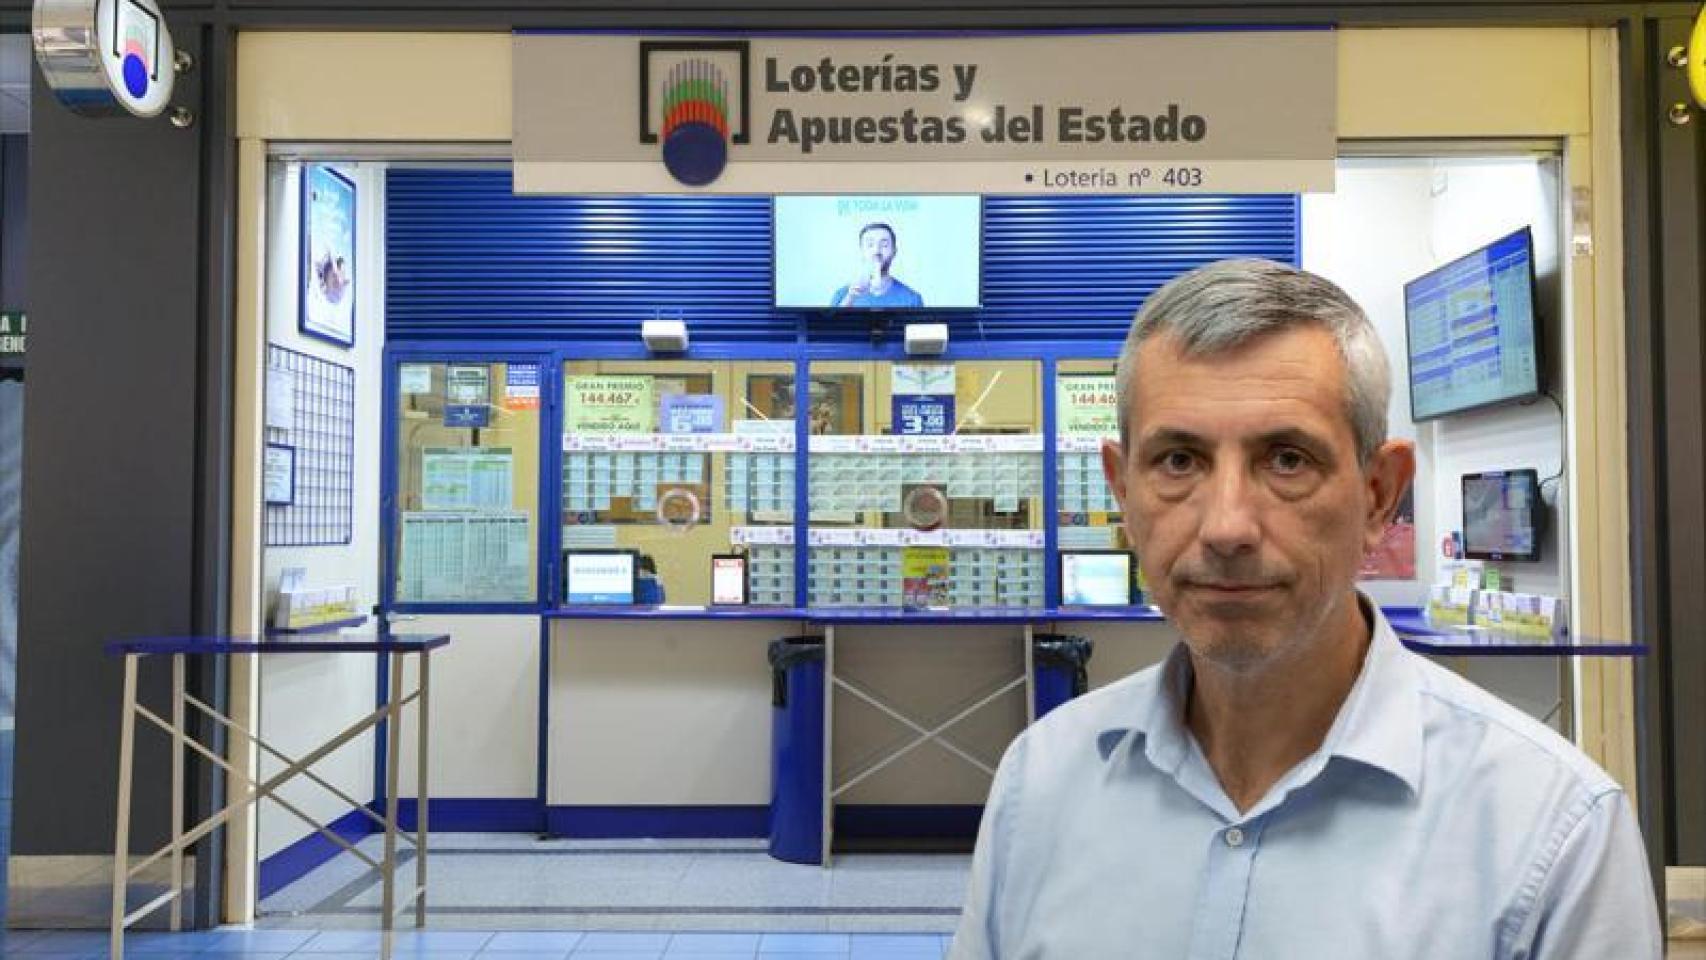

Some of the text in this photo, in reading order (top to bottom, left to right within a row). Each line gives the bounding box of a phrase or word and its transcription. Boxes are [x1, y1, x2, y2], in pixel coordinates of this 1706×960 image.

[765, 53, 978, 101] Loterías y
[767, 104, 1207, 154] Apuestas del Estado
[1127, 168, 1151, 187] nº
[1161, 167, 1202, 187] 403
